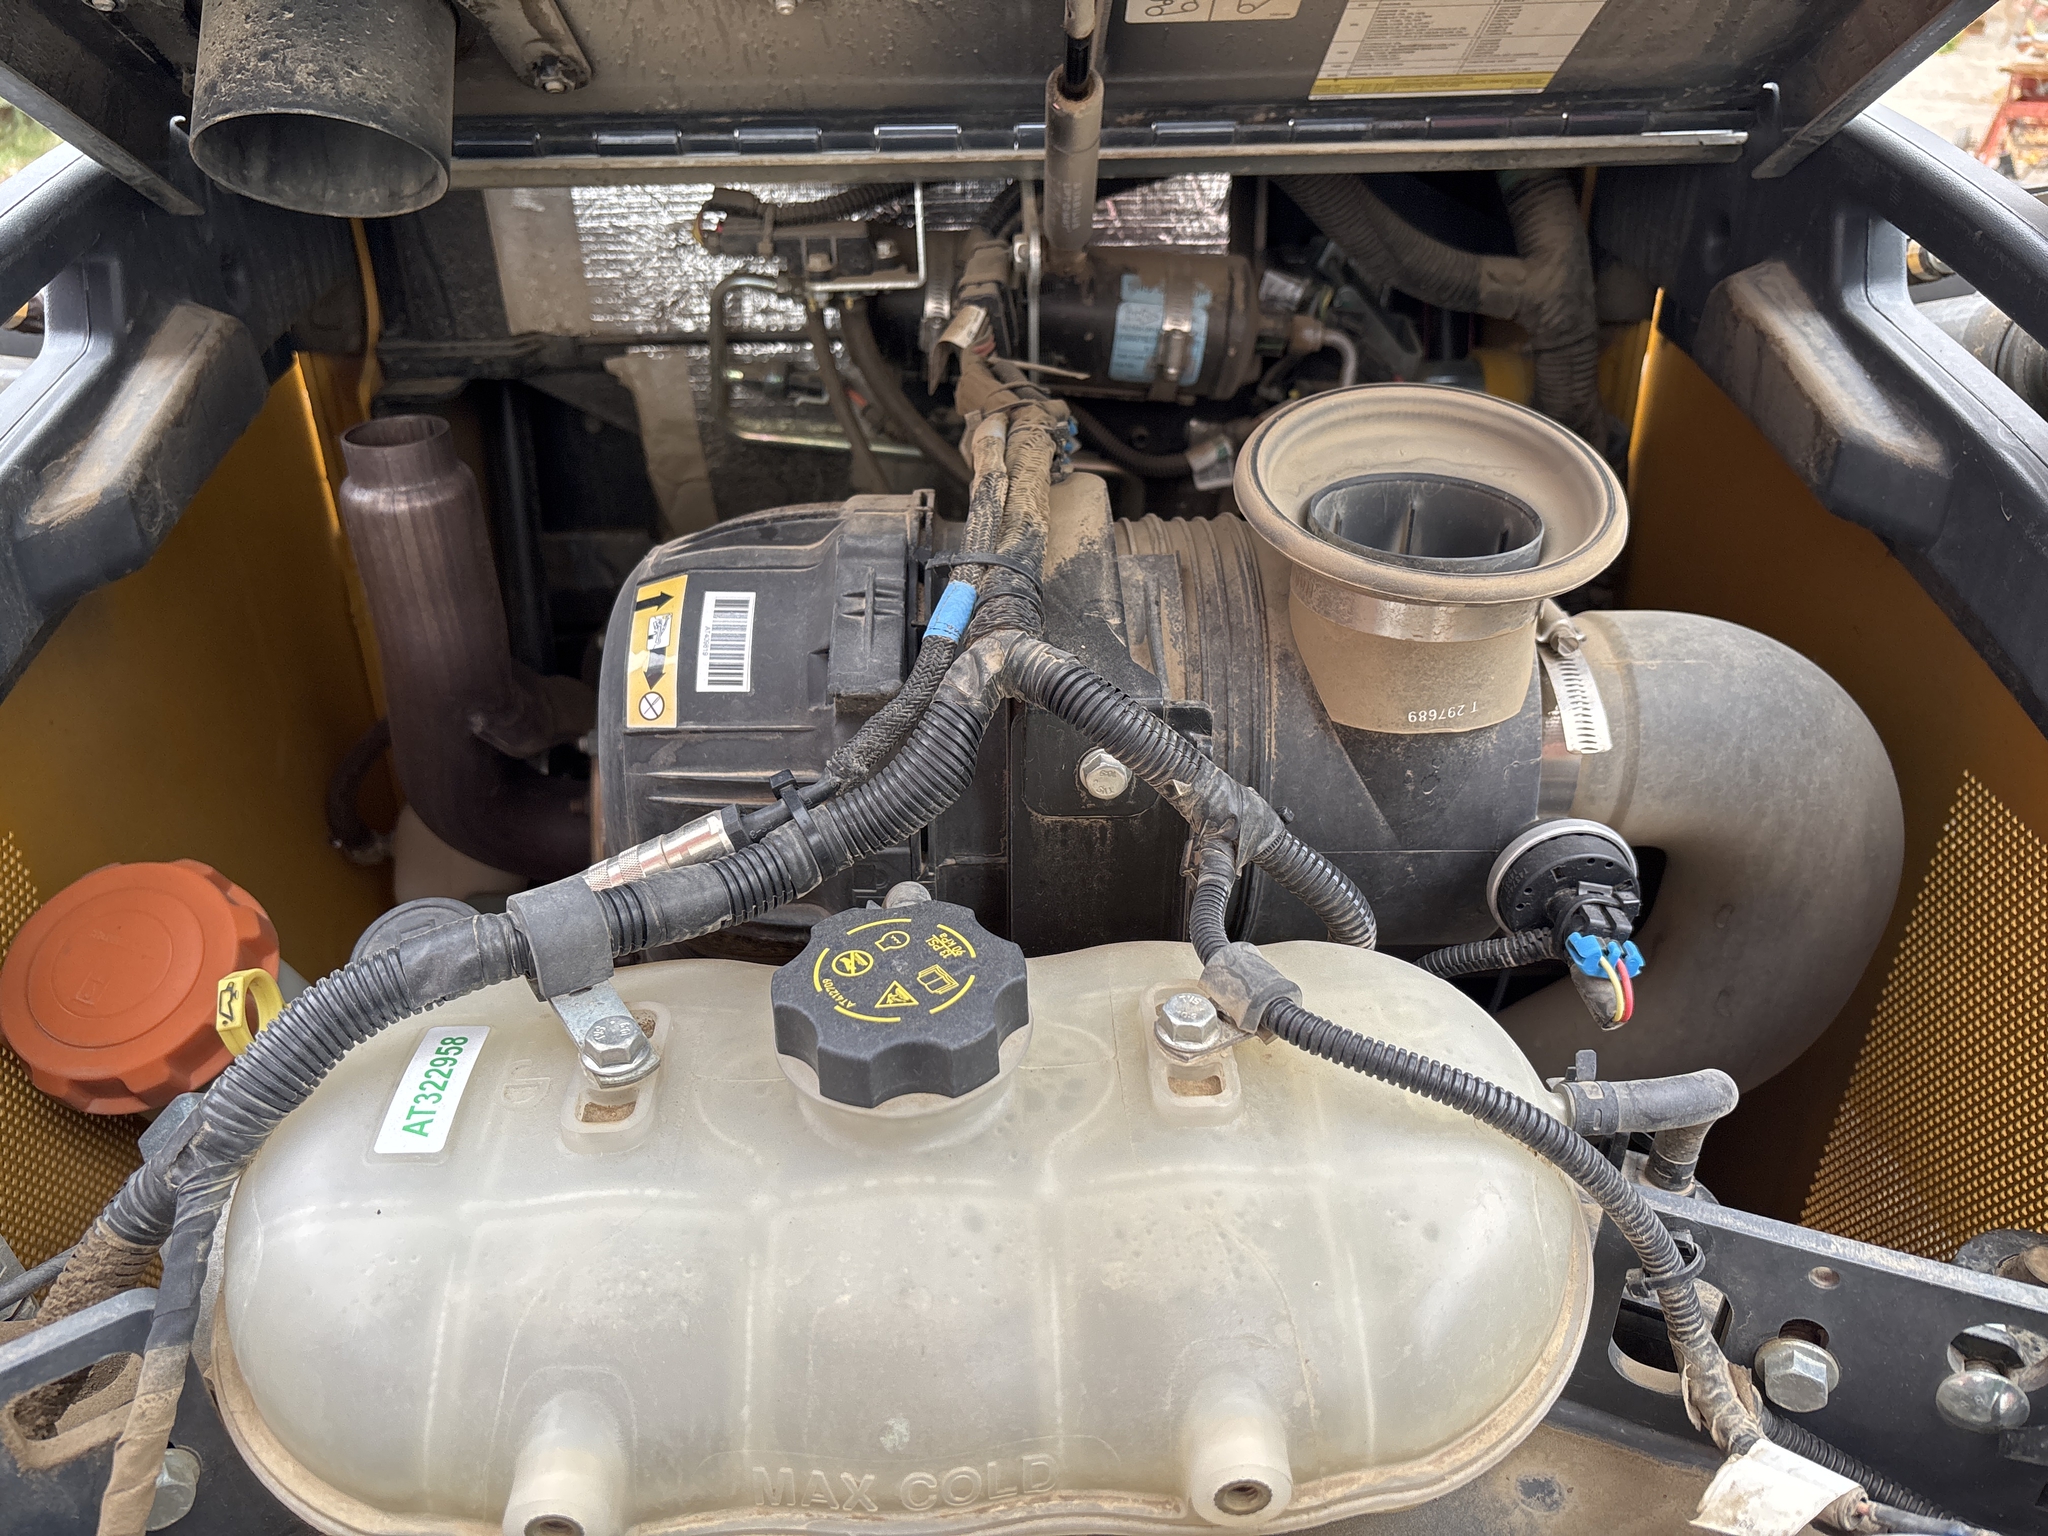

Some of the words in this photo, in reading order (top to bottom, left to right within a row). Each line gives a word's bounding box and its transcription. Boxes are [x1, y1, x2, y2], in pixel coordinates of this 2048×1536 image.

[1407, 704, 1465, 723] 297689
[925, 937, 944, 951] PSI
[402, 1036, 469, 1137] AT322958
[752, 1466, 878, 1512] MAX
[901, 1453, 1057, 1511] COLD
